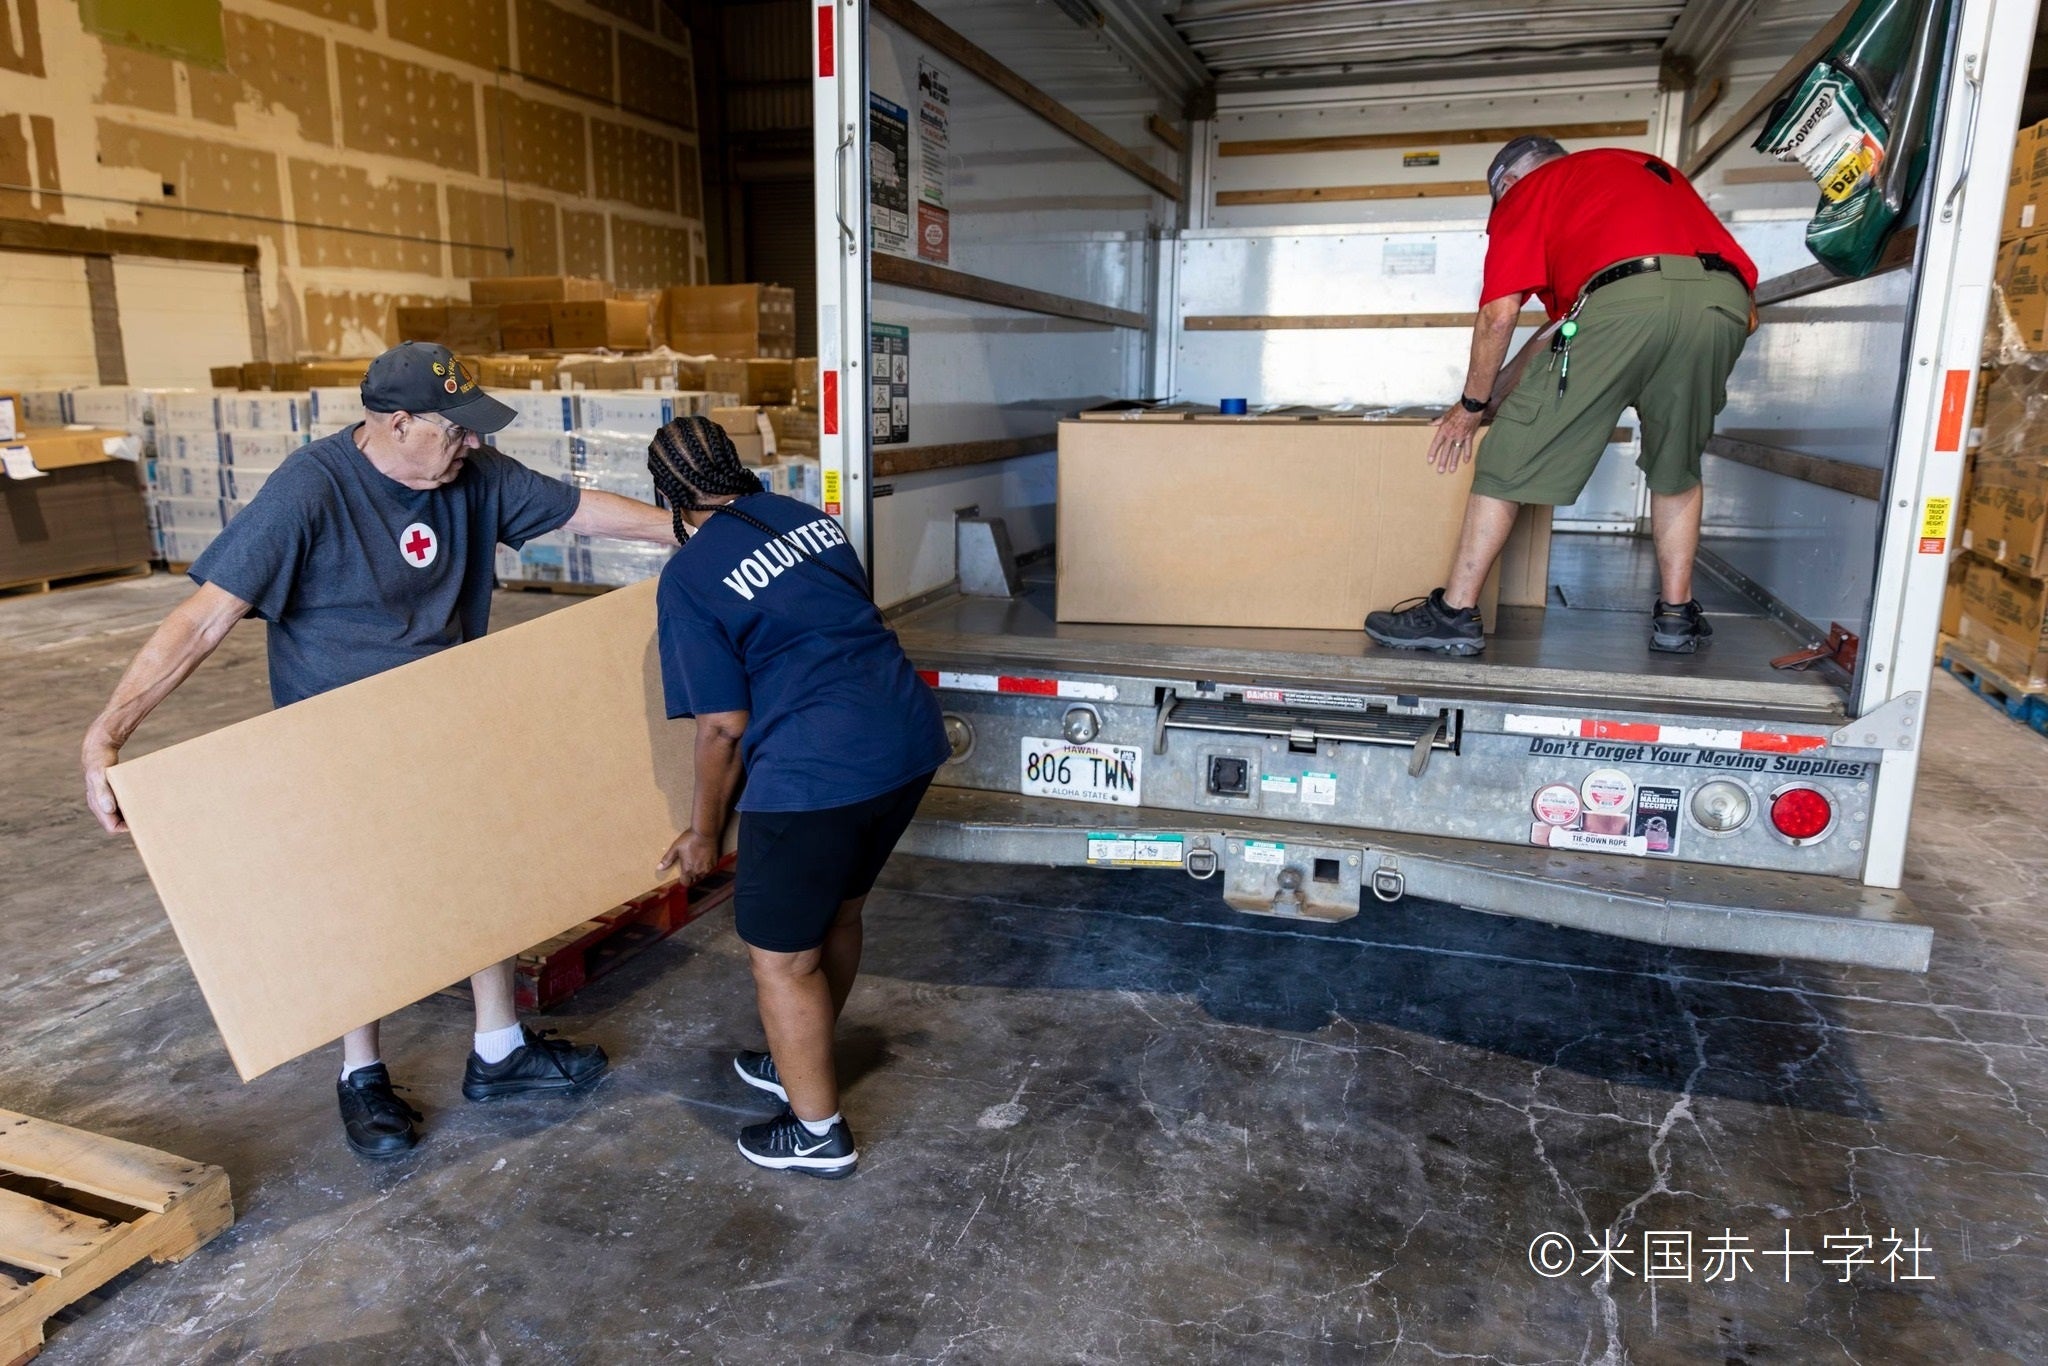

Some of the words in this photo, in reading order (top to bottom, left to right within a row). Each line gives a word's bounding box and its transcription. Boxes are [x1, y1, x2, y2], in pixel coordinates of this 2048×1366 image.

[722, 518, 847, 601] VOLUNTEE
[1246, 690, 1279, 701] DANGER
[1063, 745, 1099, 755] HAWAII
[1529, 736, 1578, 756] Don't
[1584, 741, 1644, 761] Forget
[1650, 747, 1694, 764] Your
[1696, 750, 1767, 772] Moving
[1773, 755, 1868, 777] Supplies!
[1027, 752, 1071, 785] 806
[1089, 757, 1134, 791] TWN
[1051, 788, 1080, 799] ALOHA
[1082, 791, 1109, 801] STATE
[1640, 796, 1678, 805] MAXIMUM
[1639, 803, 1678, 811] SECURITY
[1572, 834, 1607, 846] TIE-DOWN
[1608, 836, 1628, 847] ROPE
